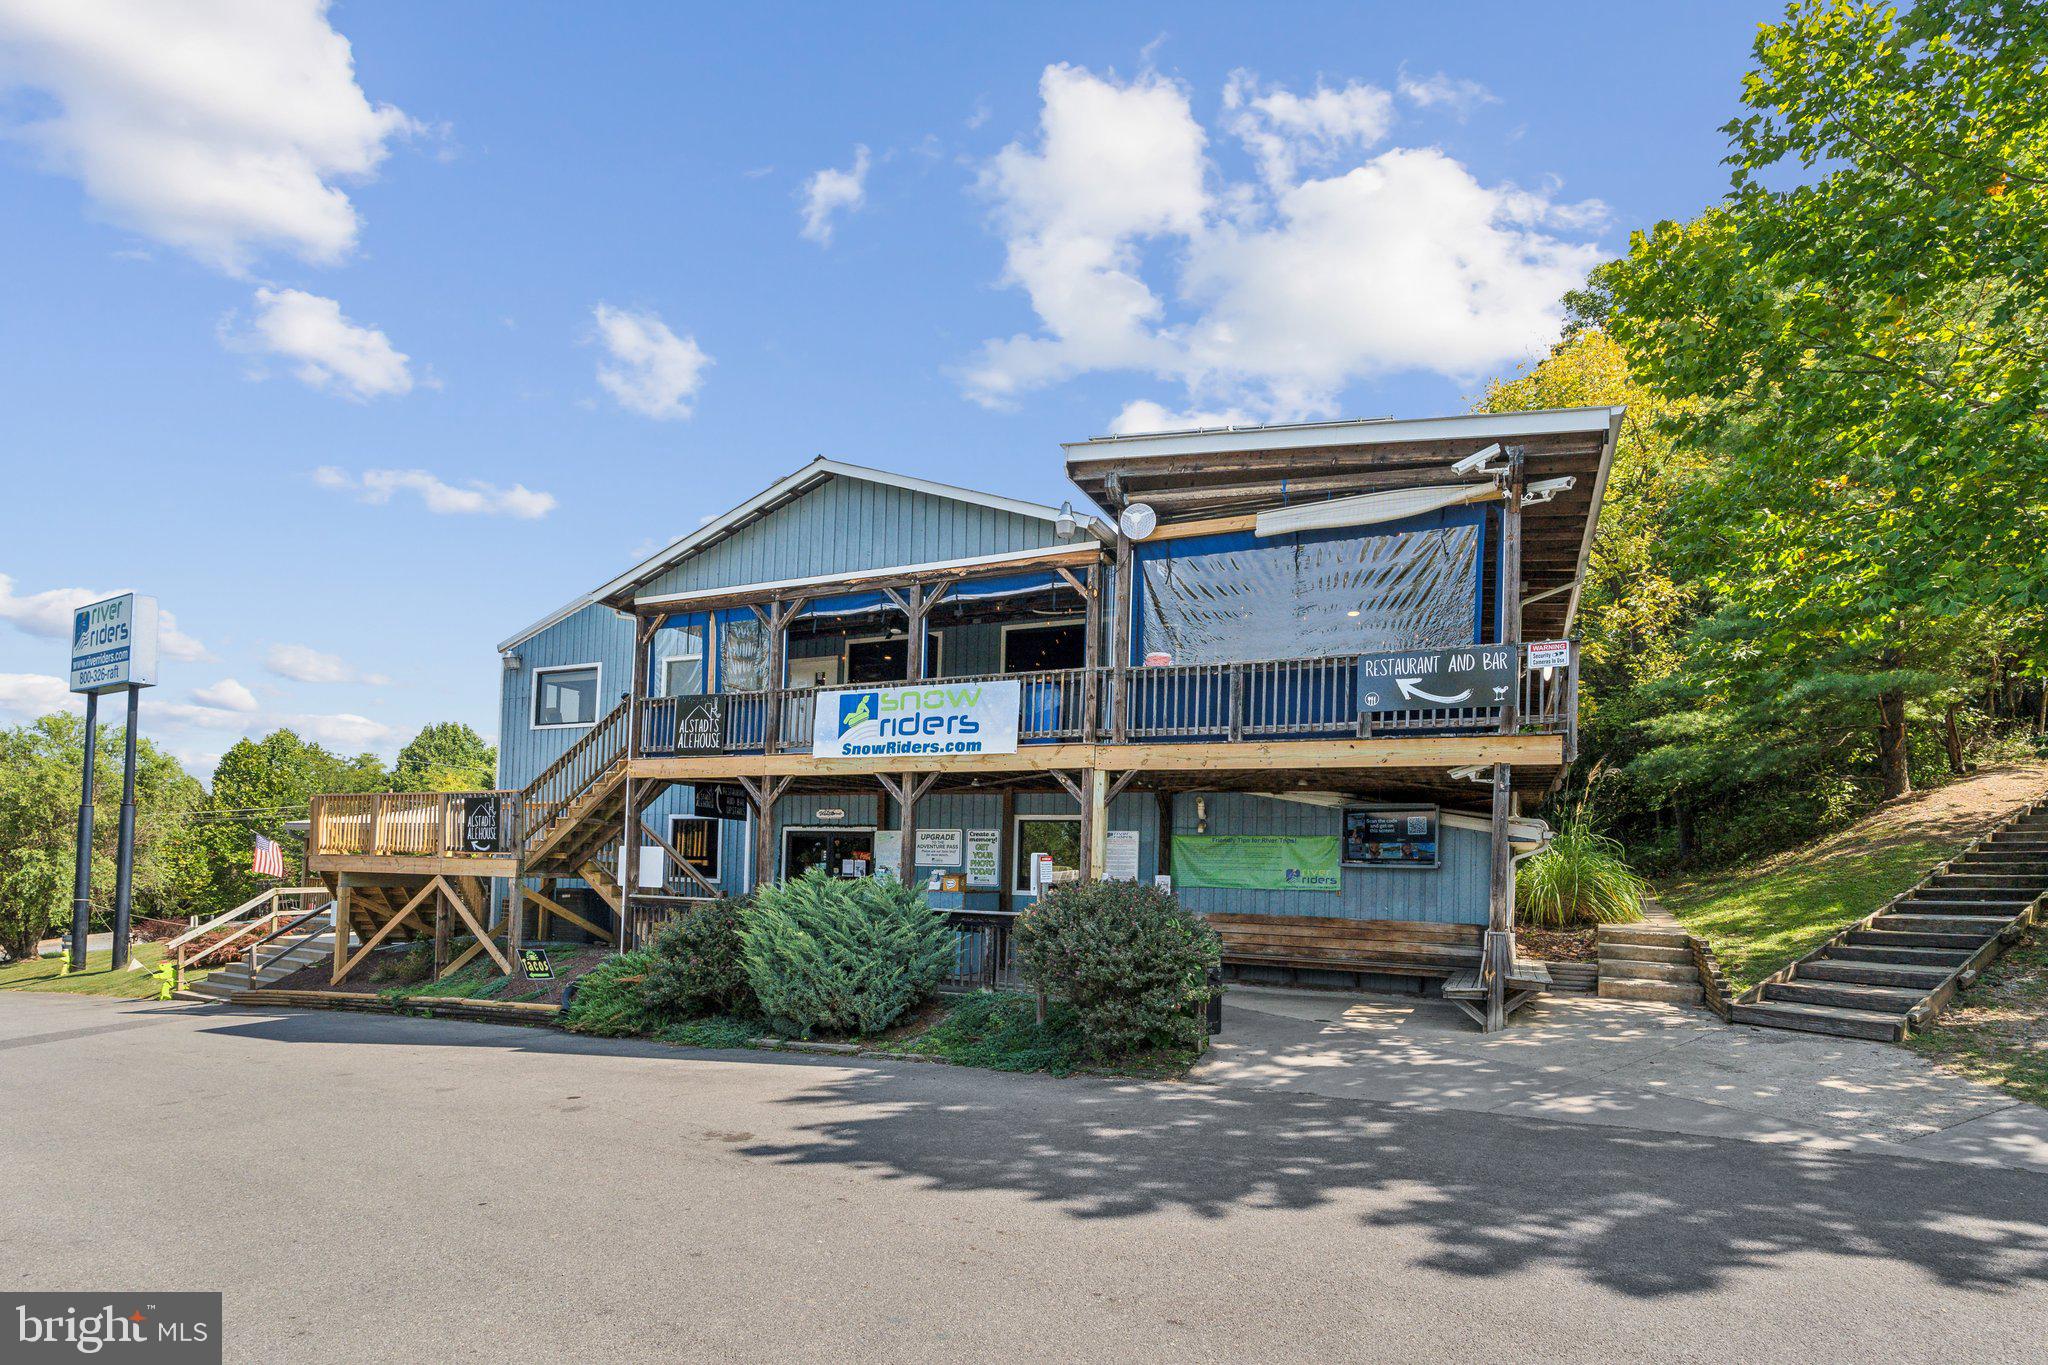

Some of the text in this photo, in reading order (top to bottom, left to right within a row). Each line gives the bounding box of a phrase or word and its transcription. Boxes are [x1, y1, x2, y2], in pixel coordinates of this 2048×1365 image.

[91, 601, 122, 624] river
[90, 622, 128, 646] riders
[80, 665, 120, 684] 800-326-raft
[1366, 652, 1508, 677] RESTAURANT AND BAR
[880, 688, 983, 711] snow
[879, 712, 980, 737] riders
[842, 740, 982, 756] SnowRiders.com
[1302, 876, 1337, 884] riders
[521, 958, 549, 972] Tacos
